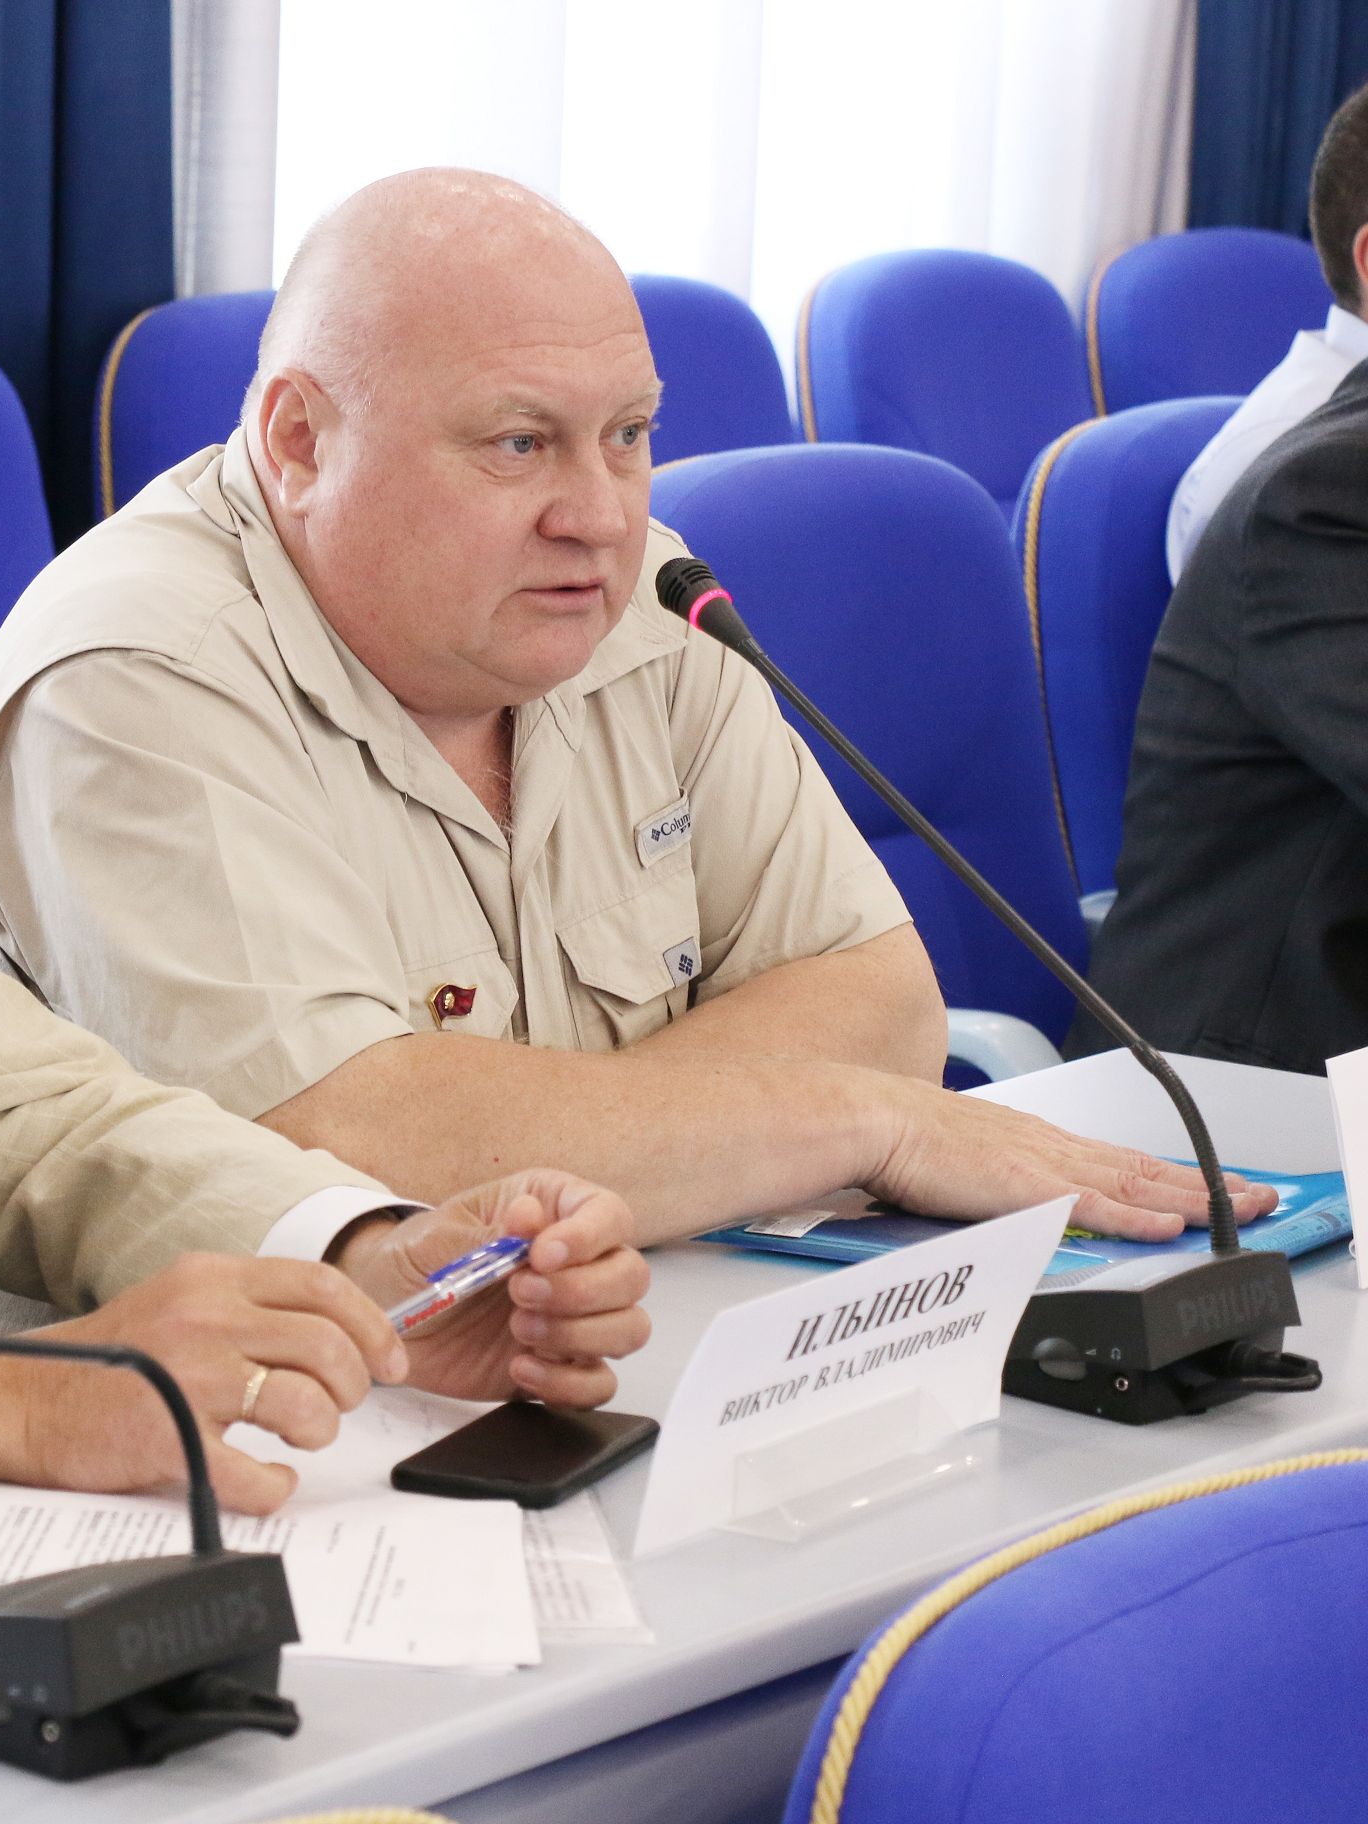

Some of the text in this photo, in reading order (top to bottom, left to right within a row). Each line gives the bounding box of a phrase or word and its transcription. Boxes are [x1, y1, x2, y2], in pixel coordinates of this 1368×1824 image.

[661, 813, 691, 836] Colum
[785, 1264, 974, 1362] ИЛЬИНОВ
[719, 1310, 987, 1426] ВИКТОР ВЛАДИМИРОВИЧ
[116, 1581, 269, 1671] PHILIPS
